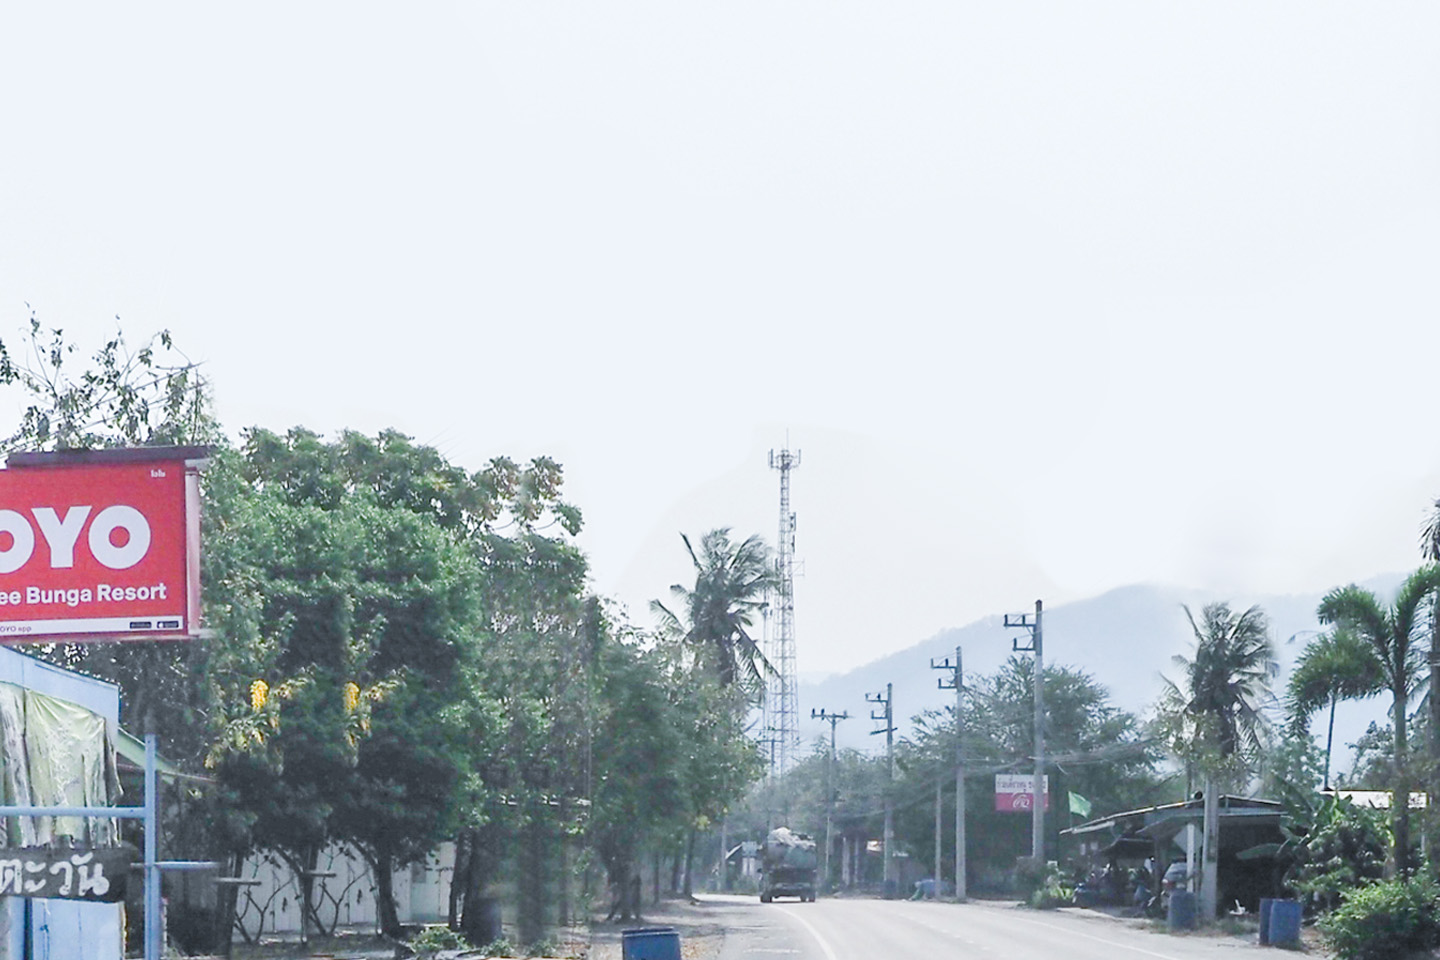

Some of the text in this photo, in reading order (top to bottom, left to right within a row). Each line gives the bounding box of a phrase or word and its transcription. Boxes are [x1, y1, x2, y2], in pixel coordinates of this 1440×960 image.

[26, 586, 92, 606] Bunga
[97, 583, 167, 602] Resort
[18, 626, 32, 634] app
